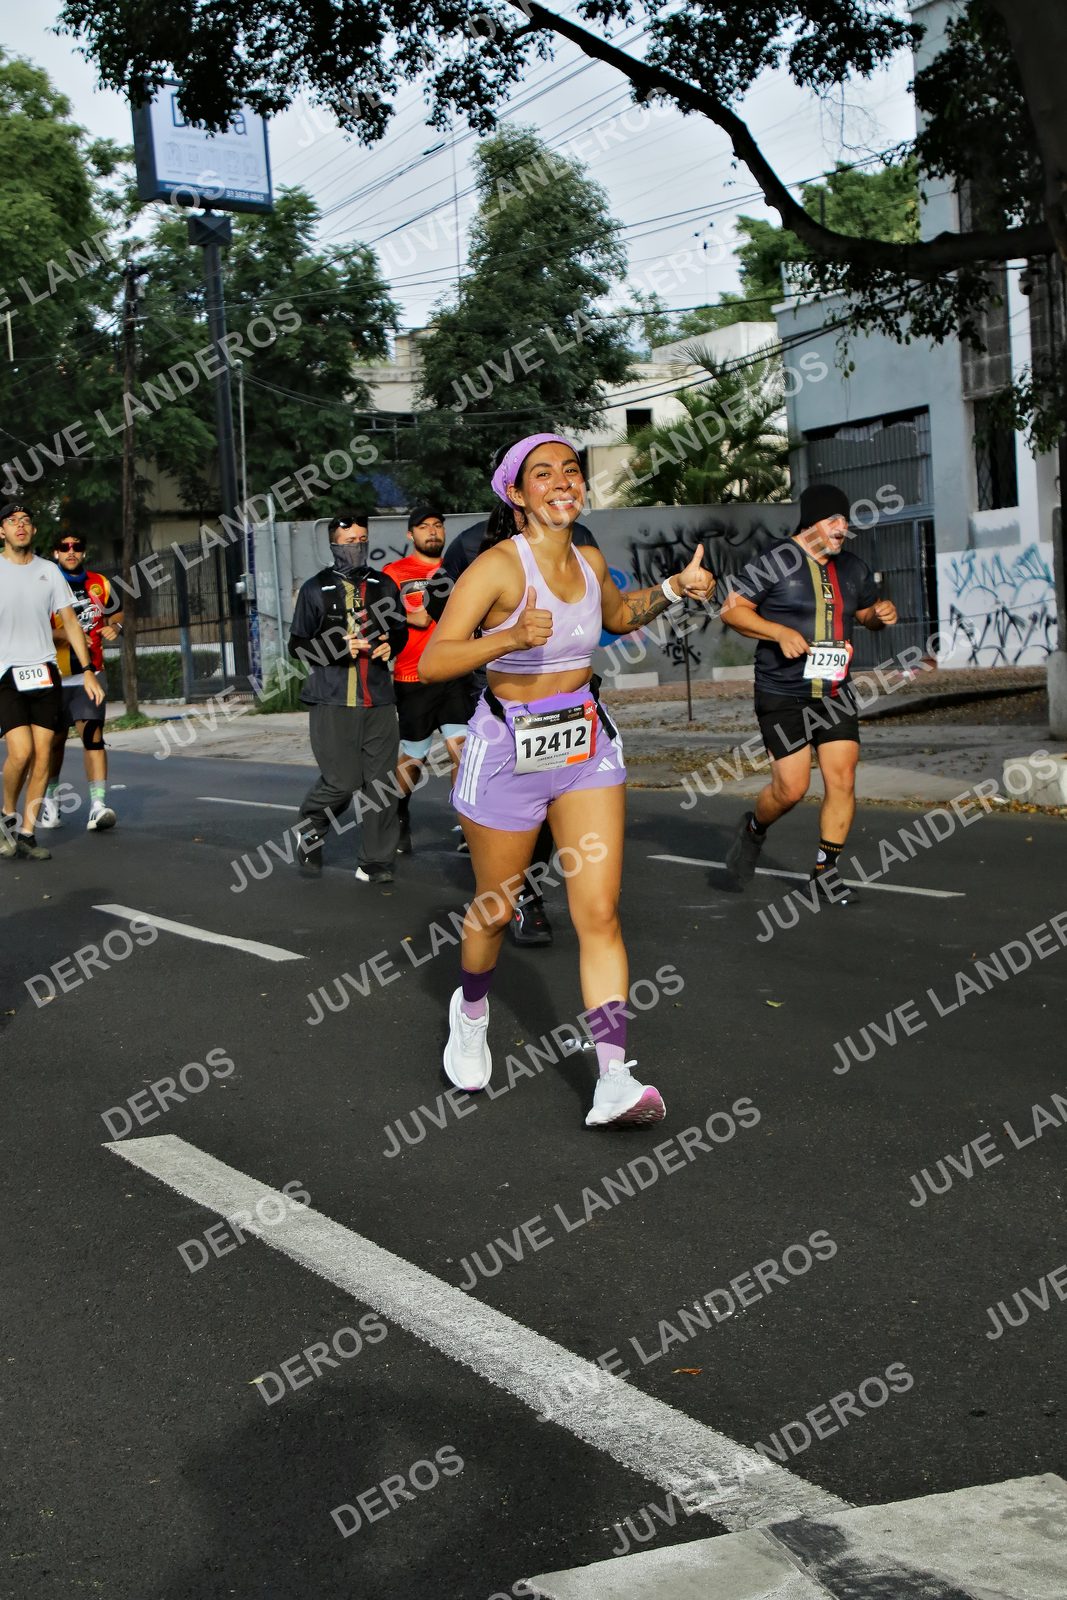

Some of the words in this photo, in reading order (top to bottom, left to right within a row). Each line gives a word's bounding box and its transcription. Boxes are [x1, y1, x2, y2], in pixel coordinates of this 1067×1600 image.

[811, 652, 847, 667] 12790
[18, 667, 43, 681] 8510
[521, 725, 587, 759] 12412
